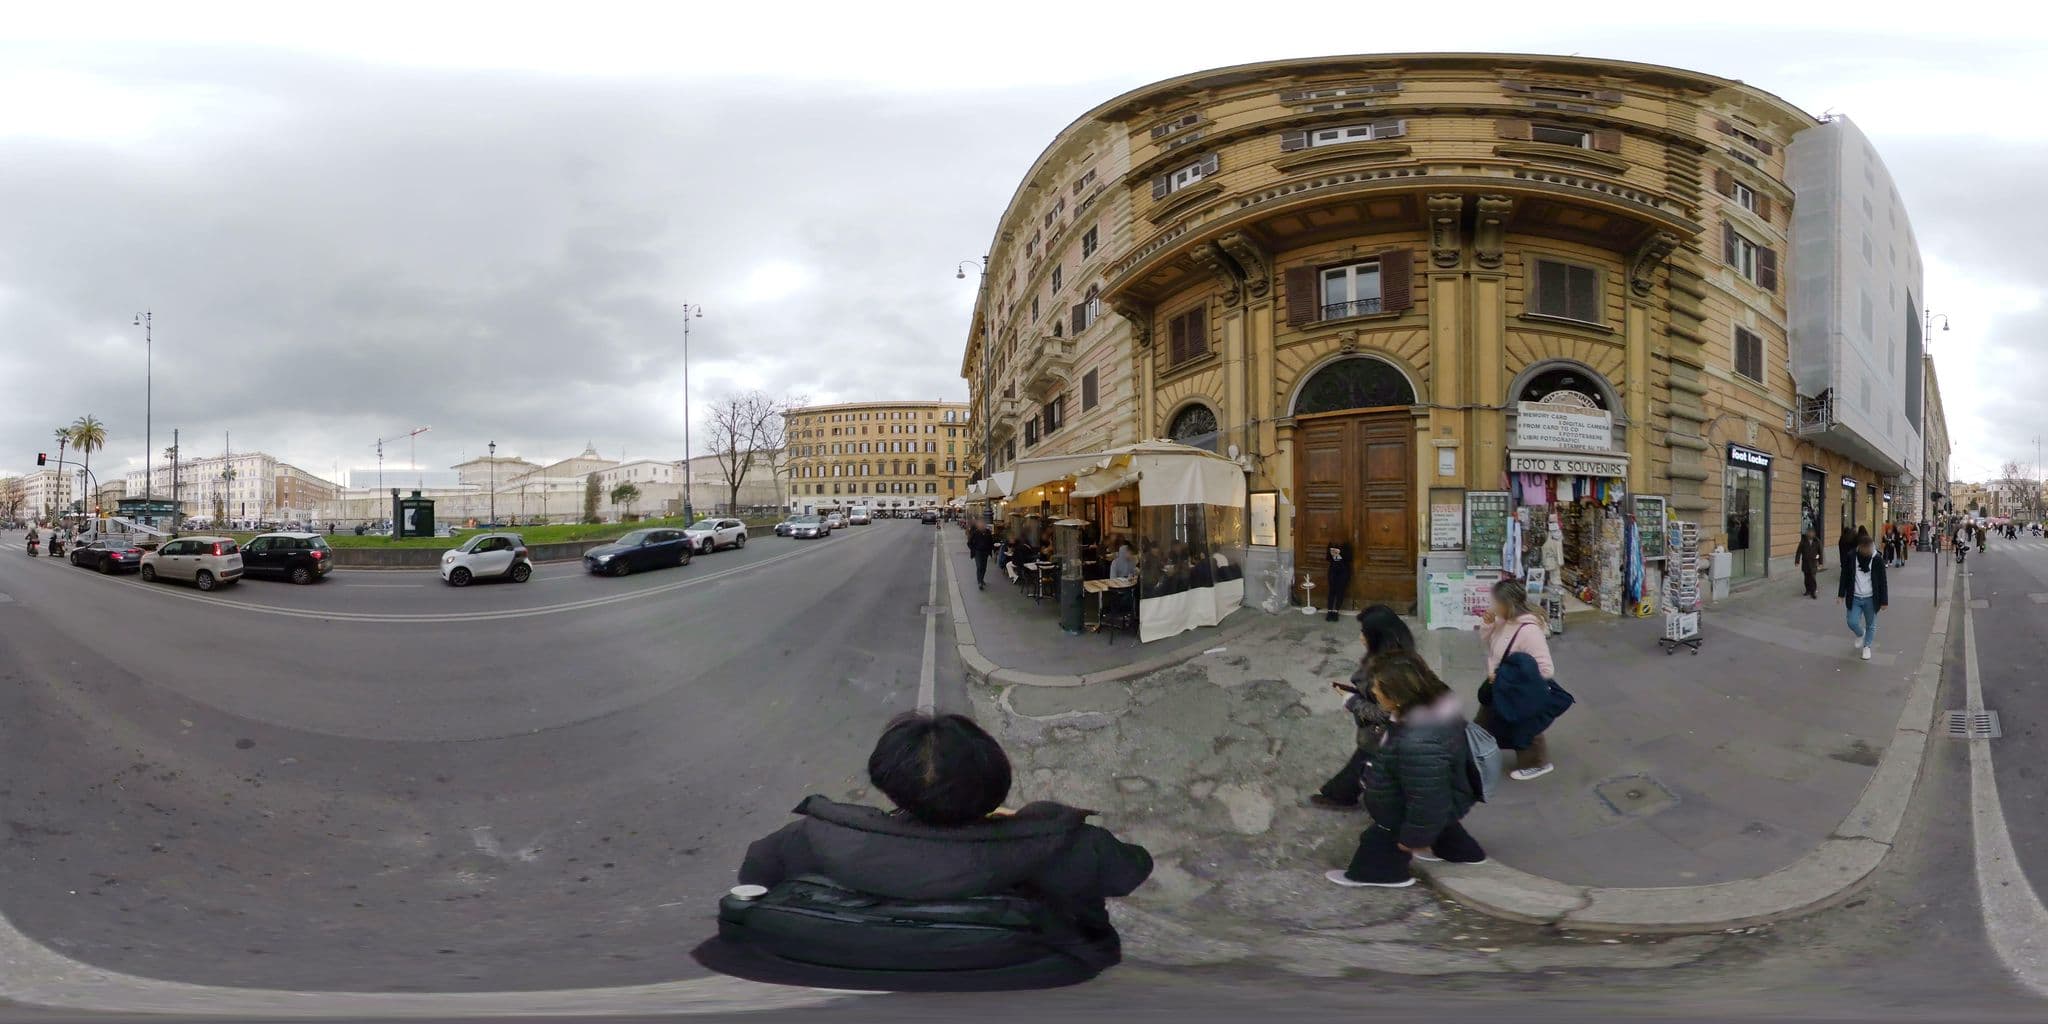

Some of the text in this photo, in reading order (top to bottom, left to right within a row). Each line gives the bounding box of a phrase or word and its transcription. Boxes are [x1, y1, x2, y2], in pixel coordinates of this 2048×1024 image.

[1517, 459, 1622, 474] FOTO & SOUVENIRS
[1748, 453, 1768, 466] Locker
